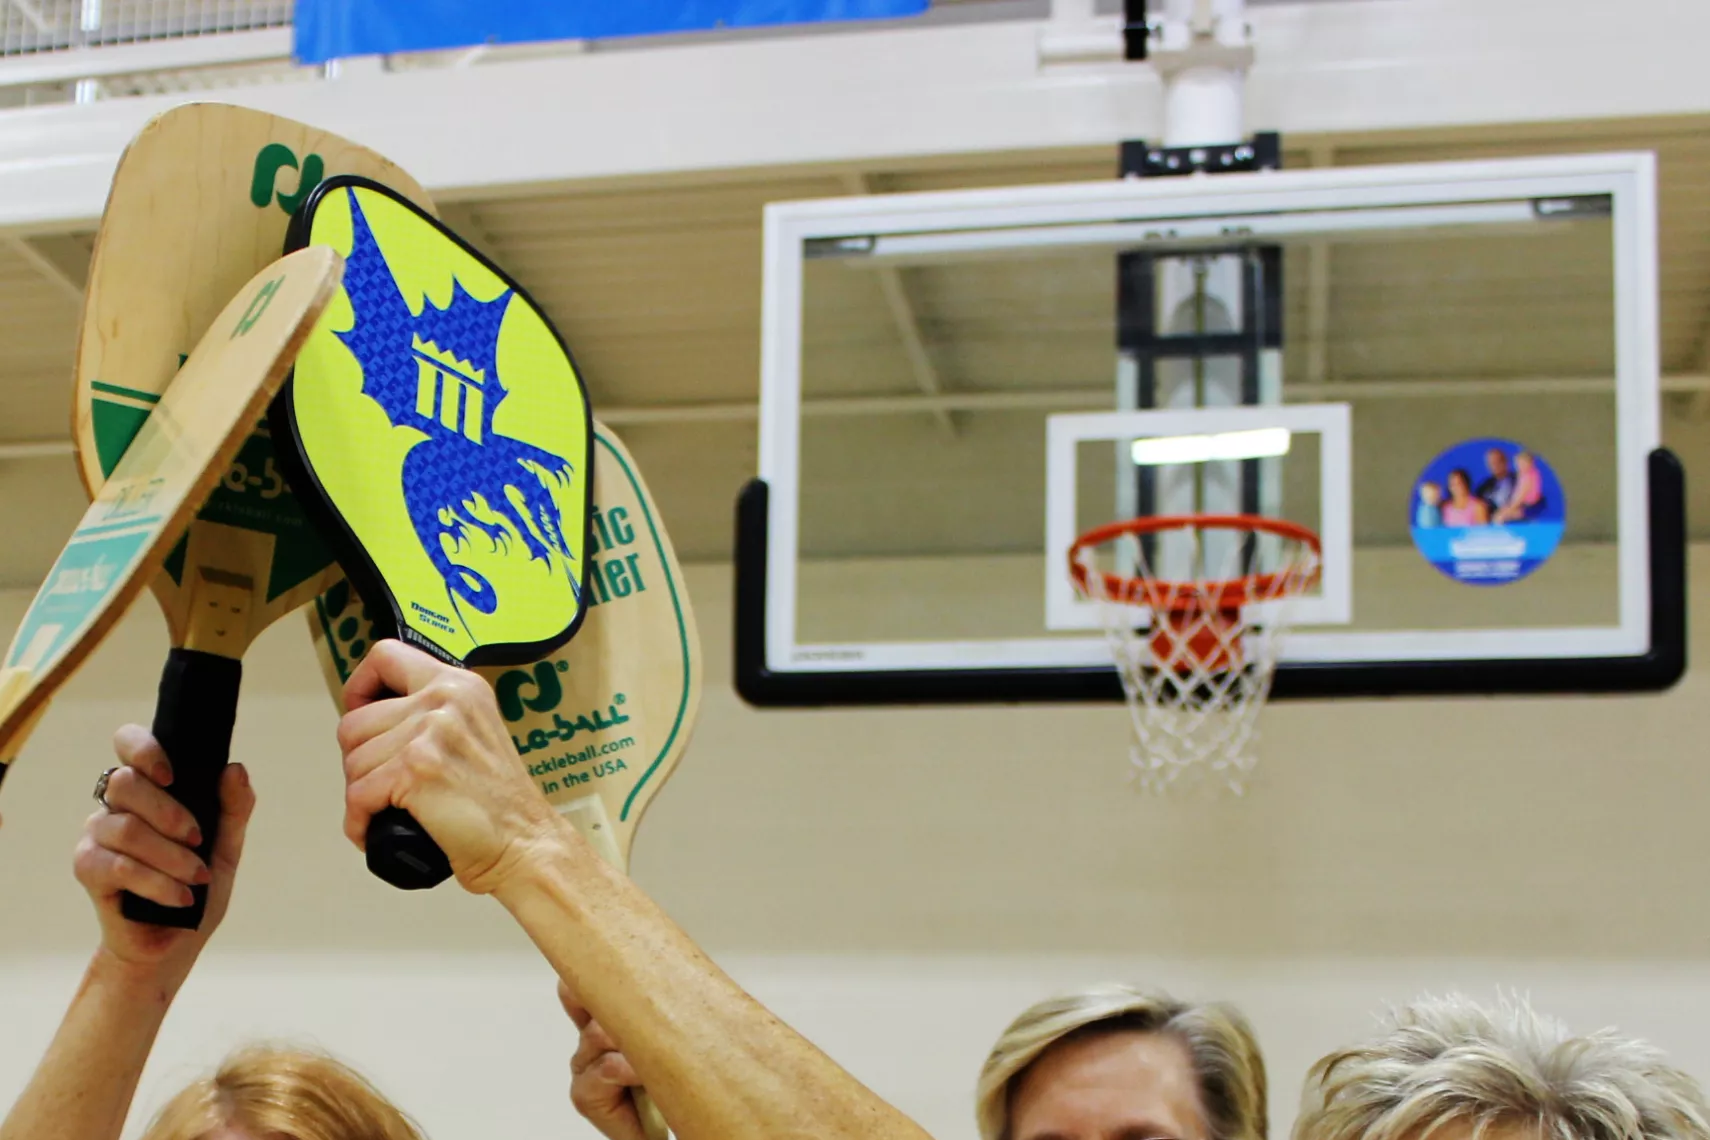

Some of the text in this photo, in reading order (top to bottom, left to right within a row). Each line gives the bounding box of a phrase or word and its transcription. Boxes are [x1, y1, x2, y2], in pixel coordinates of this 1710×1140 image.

[527, 737, 637, 777] ickleball.com
[562, 771, 591, 789] the
[592, 758, 628, 778] USA
